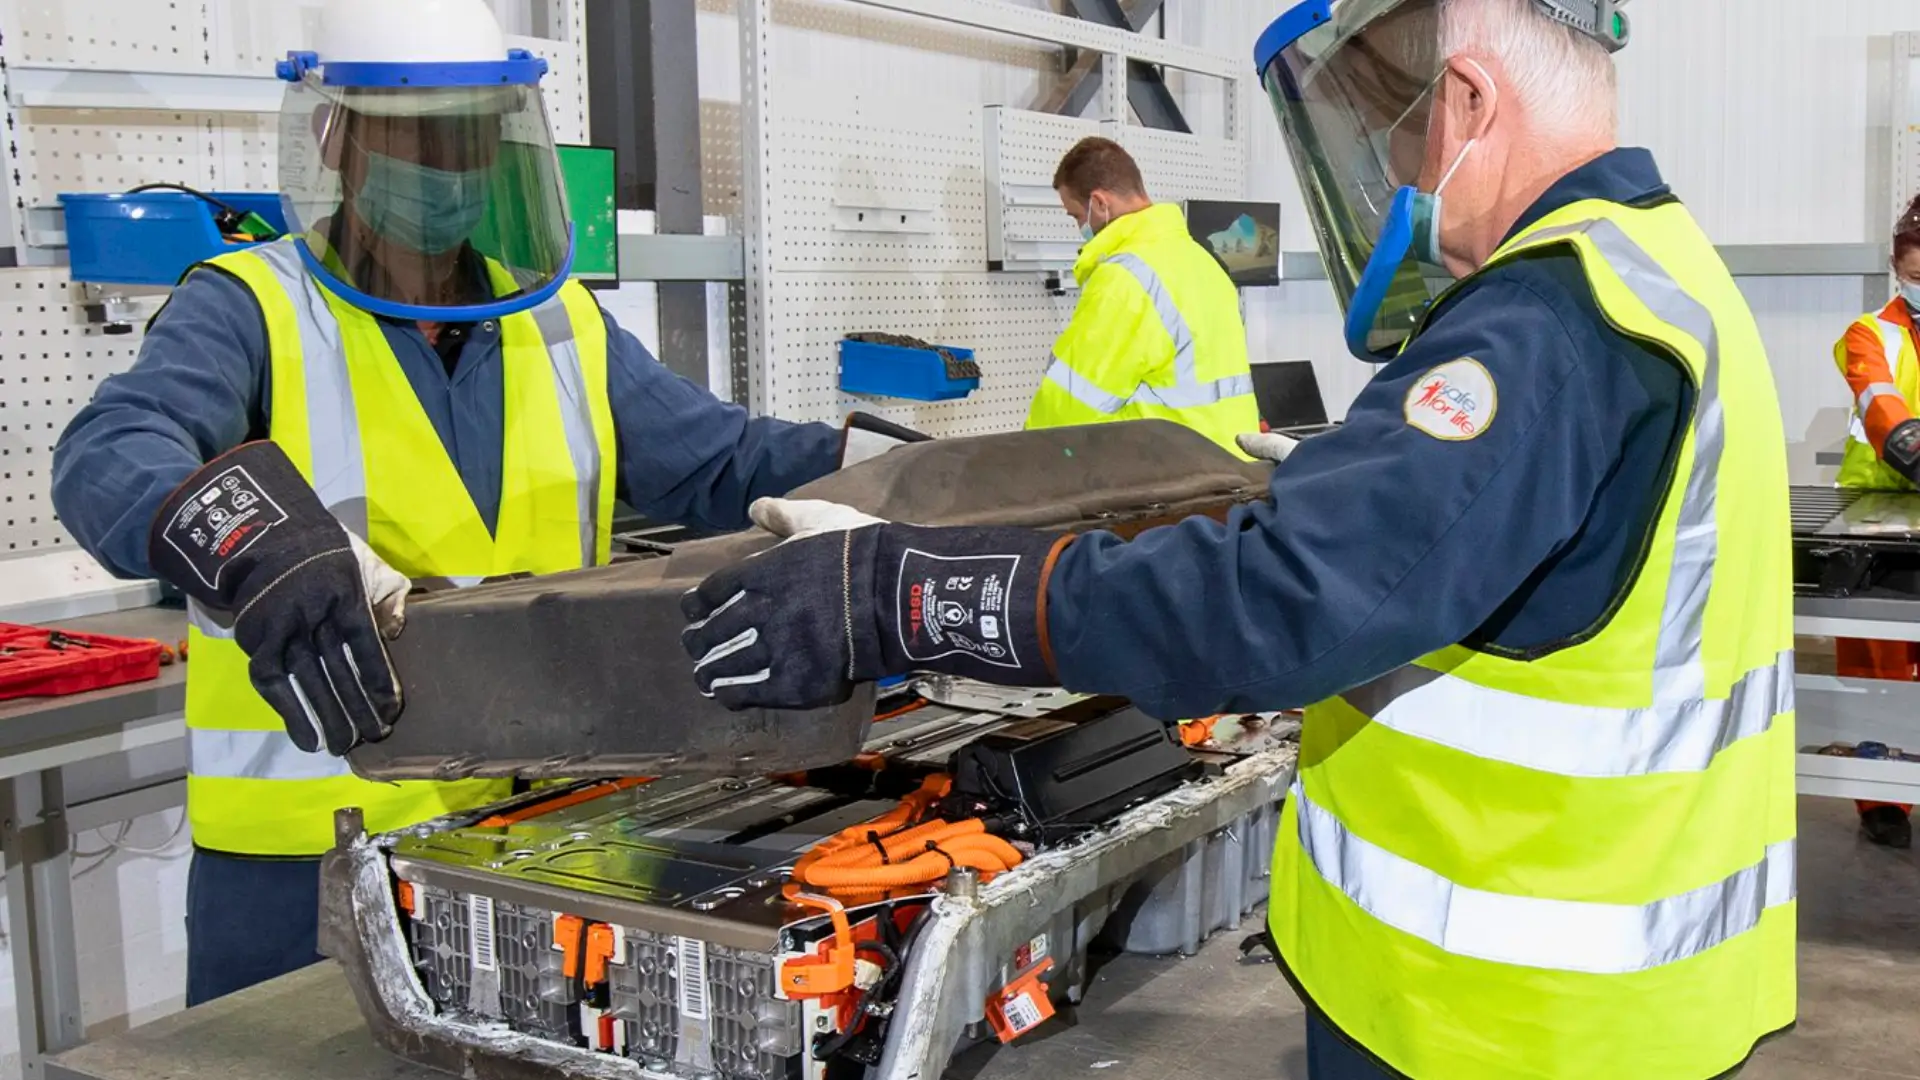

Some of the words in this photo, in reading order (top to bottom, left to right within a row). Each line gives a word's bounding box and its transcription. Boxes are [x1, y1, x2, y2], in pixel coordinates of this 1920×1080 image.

[1427, 392, 1455, 414] for
[1450, 409, 1475, 434] life
[1440, 385, 1476, 412] safe
[958, 575, 974, 590] CE
[909, 584, 923, 620] BSD
